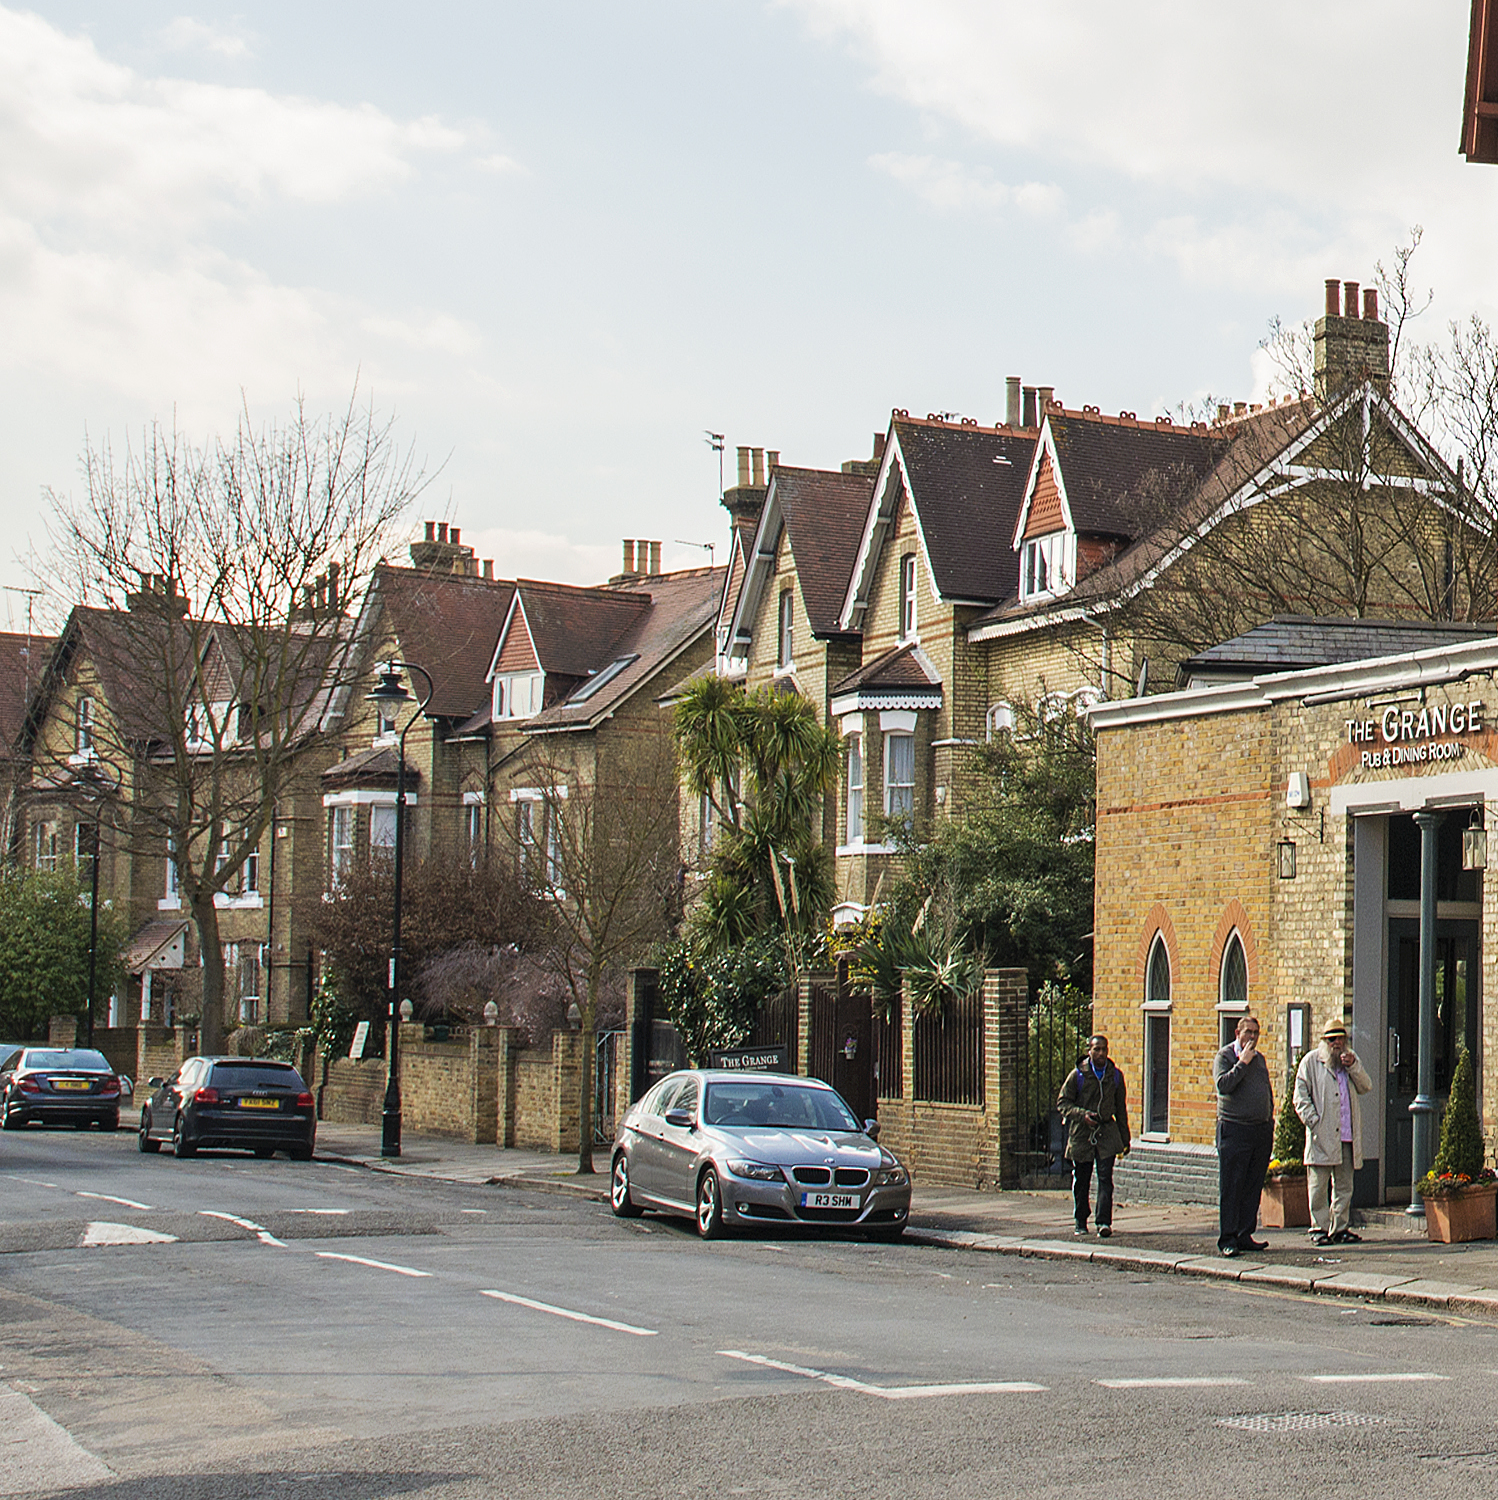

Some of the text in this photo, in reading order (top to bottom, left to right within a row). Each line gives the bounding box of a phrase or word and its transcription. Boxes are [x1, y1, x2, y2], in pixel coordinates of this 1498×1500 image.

[1345, 700, 1482, 743] THE GRANGE
[1361, 742, 1460, 768] PUB & DINING ROOM
[721, 1057, 741, 1068] THE
[742, 1055, 779, 1067] GRANGE
[815, 1195, 830, 1207] R3
